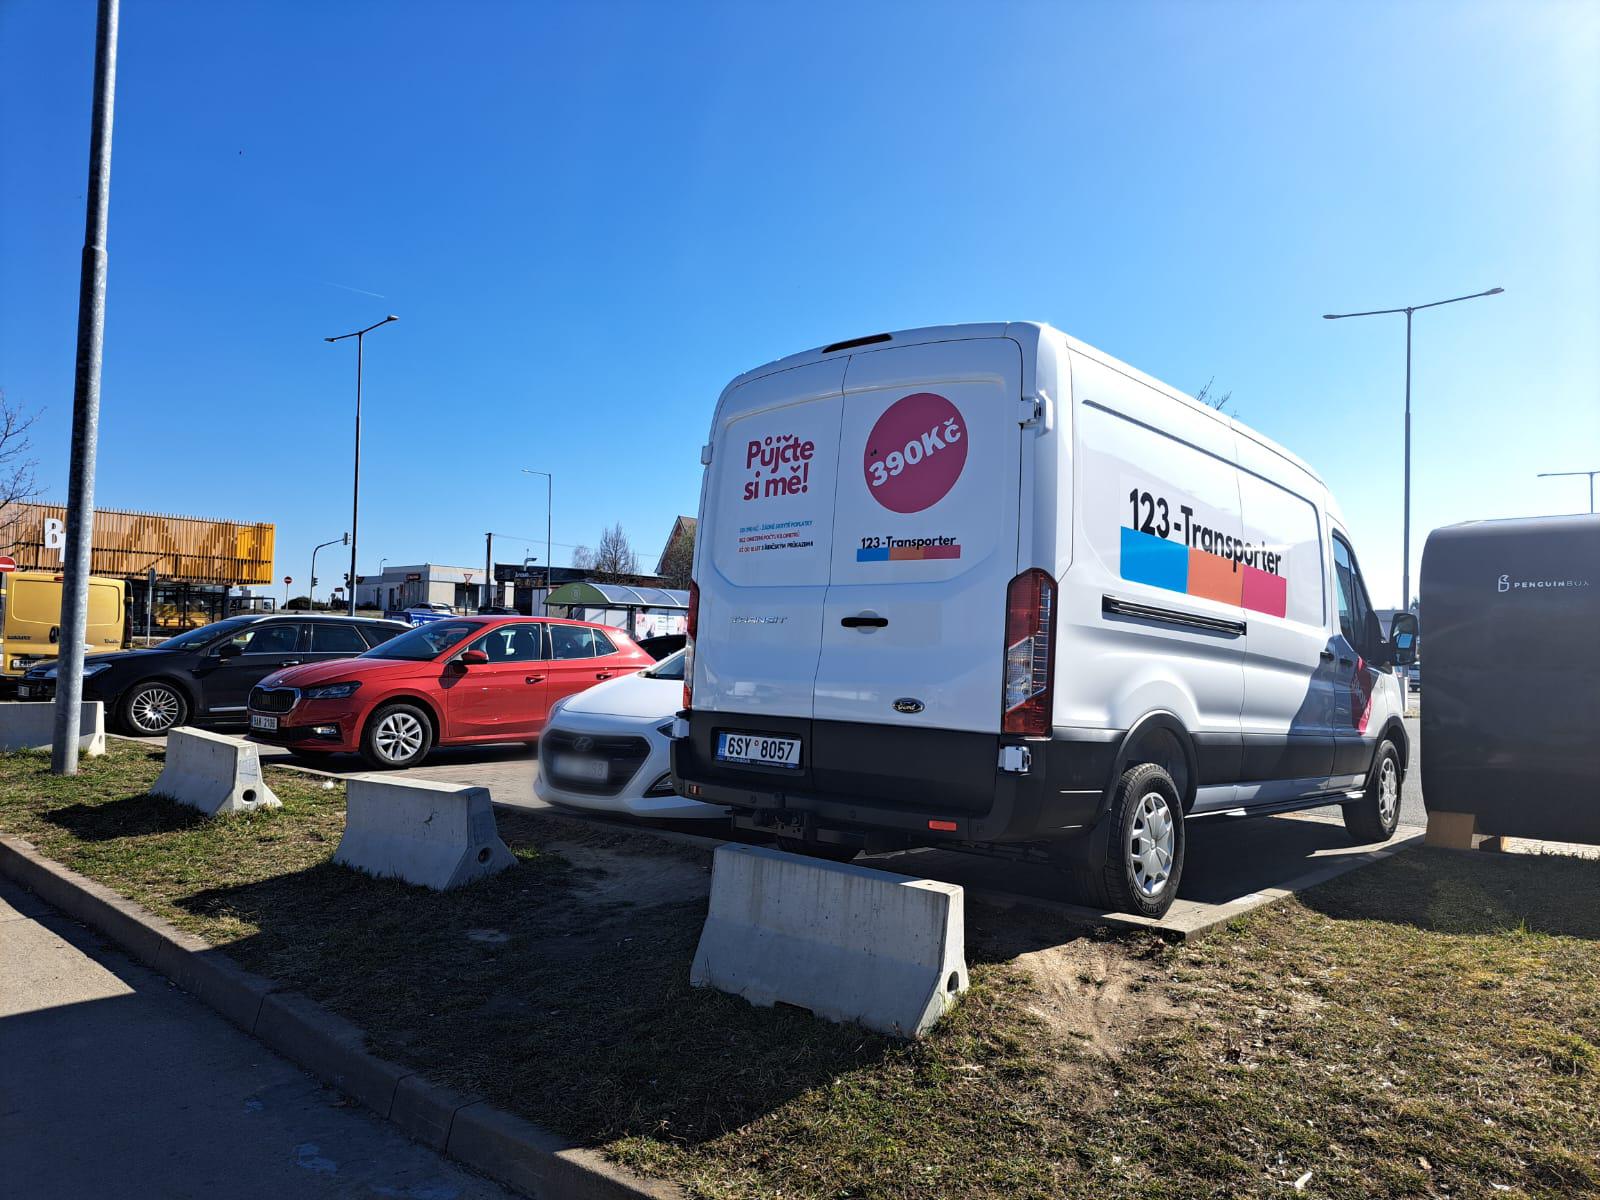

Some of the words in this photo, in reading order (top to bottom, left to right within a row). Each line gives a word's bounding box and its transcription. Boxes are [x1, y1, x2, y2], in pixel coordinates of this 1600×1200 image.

[746, 433, 815, 474] Půjčte
[869, 417, 961, 487] 390Kč
[743, 471, 760, 501] si
[765, 462, 809, 497] mě!
[861, 535, 957, 550] 123-Transporter
[728, 737, 752, 757] 6SY
[761, 740, 794, 761] 8057
